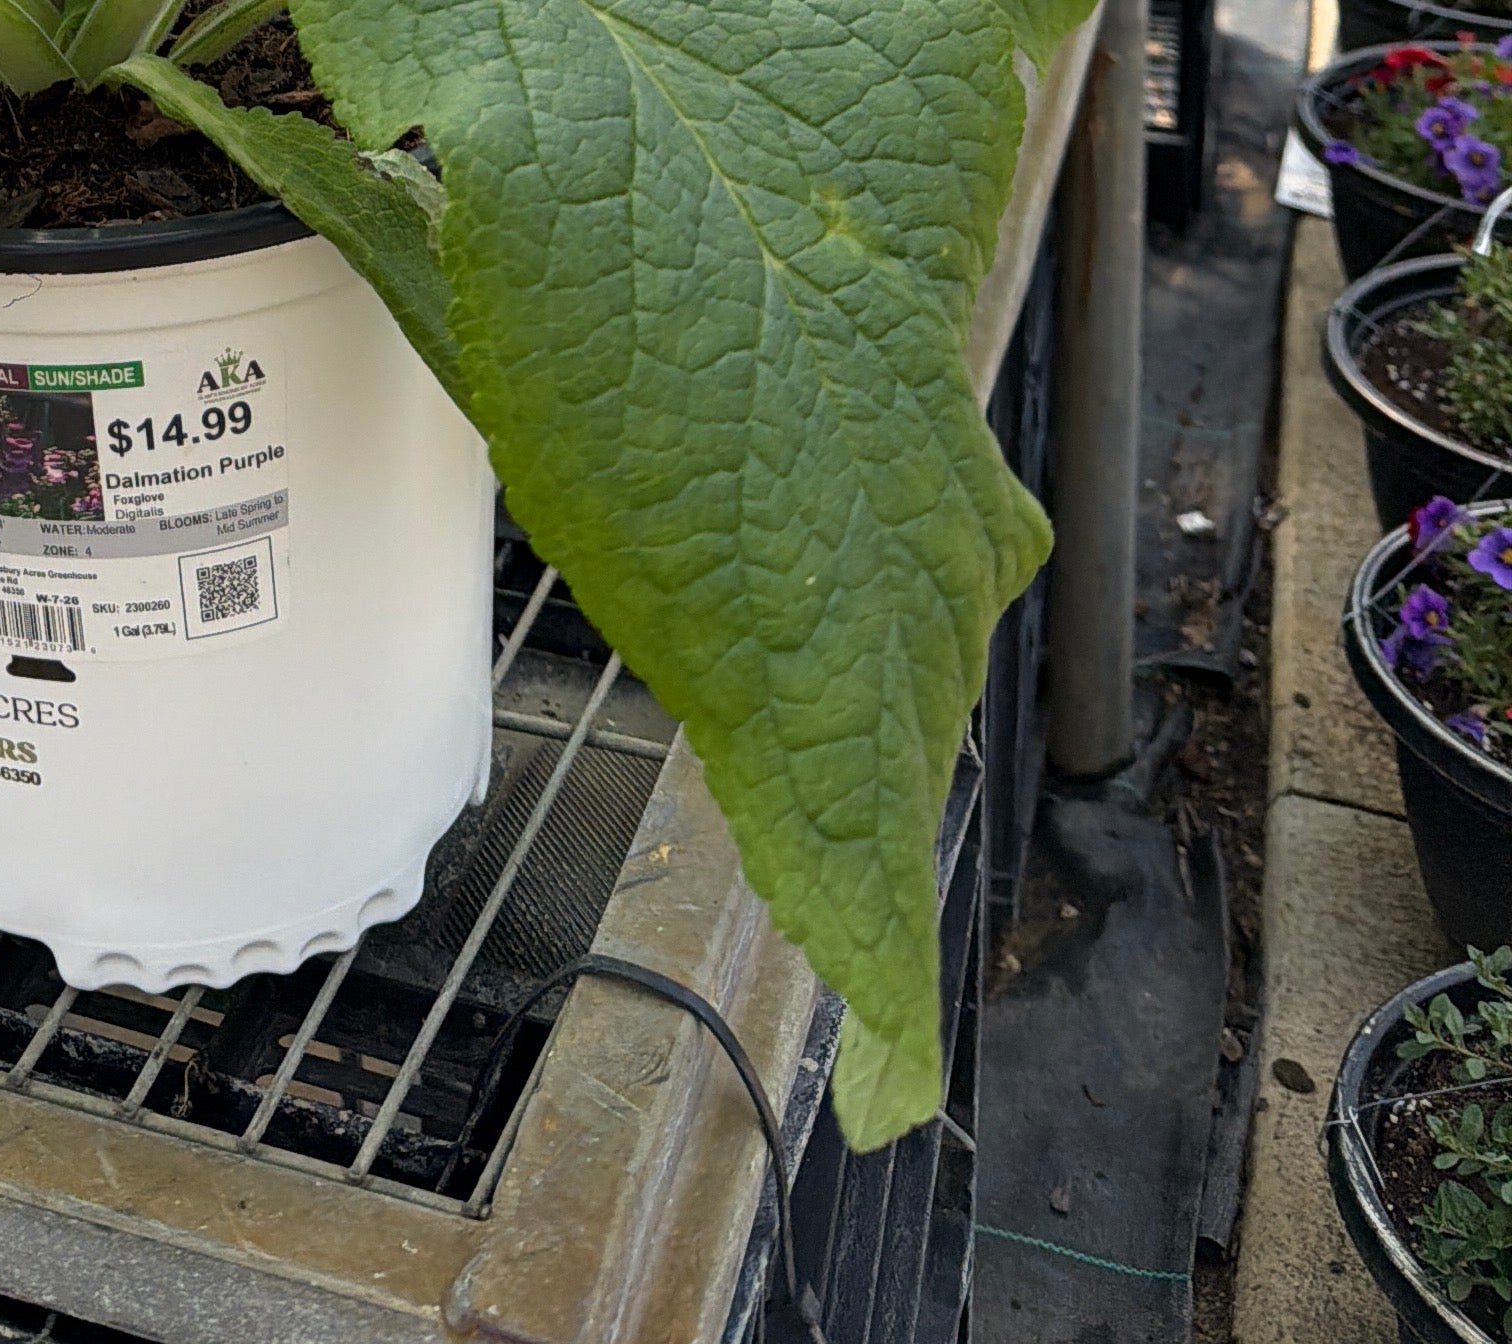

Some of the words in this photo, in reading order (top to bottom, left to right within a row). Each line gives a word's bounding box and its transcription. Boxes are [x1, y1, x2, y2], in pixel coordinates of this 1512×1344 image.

[34, 366, 136, 387] SUN/SHADE
[197, 360, 266, 393] AKA
[107, 400, 252, 458] $14.99
[106, 465, 213, 490] Dalmation
[219, 445, 285, 474] Purple
[113, 492, 165, 506] Foxglove
[115, 507, 165, 521] Digitalis
[159, 514, 213, 531] BLOOMS:
[215, 508, 238, 522] Late
[241, 499, 272, 516] Spring
[274, 493, 284, 505] to
[217, 523, 236, 536] Mid
[238, 511, 280, 530] Summer
[42, 544, 79, 557] ZONE:
[84, 546, 92, 557] 4
[7, 576, 19, 585] Rd
[23, 567, 46, 578] Acres
[48, 569, 98, 580] Greenhouse
[36, 593, 80, 606] W-7-26
[92, 602, 120, 614] SKU:
[125, 599, 171, 613] 2300260
[113, 625, 120, 638] 1
[121, 623, 140, 637] Gal
[142, 622, 177, 640] (3.79L)
